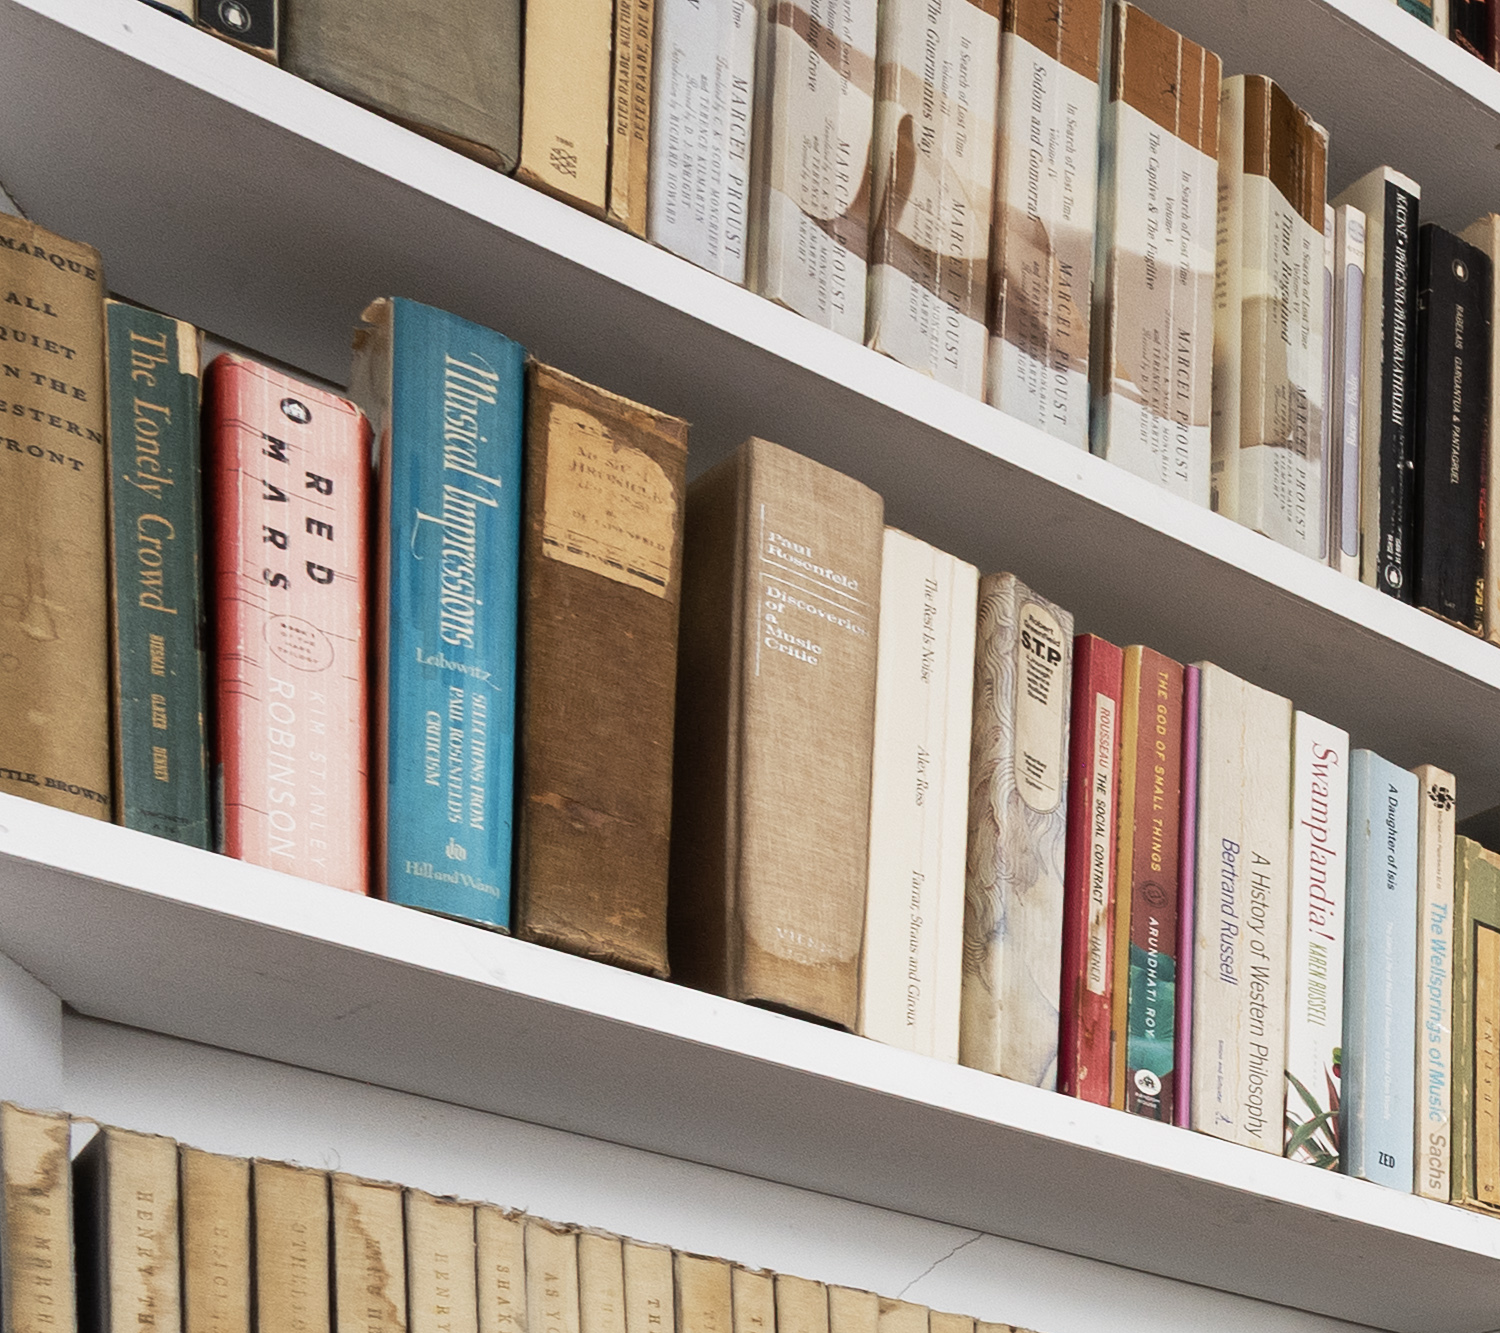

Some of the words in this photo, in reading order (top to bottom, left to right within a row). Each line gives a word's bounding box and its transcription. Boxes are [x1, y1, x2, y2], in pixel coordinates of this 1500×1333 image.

[130, 330, 167, 395] The
[131, 398, 172, 501] Lonely
[444, 353, 501, 492] Musical
[260, 435, 290, 591] MARS
[305, 473, 335, 586] RED
[132, 511, 174, 615] Crowd
[411, 489, 501, 647] Impressions
[1157, 671, 1168, 700] THE
[1154, 746, 1164, 764] OF
[1156, 707, 1166, 739] GOD
[269, 676, 298, 861] ROBINSON
[1153, 769, 1164, 816] SMALL
[1150, 822, 1163, 873] THINGS
[1220, 838, 1242, 915] Bertrand
[1252, 853, 1265, 866] A
[1308, 740, 1339, 942] Swamplandia!
[1250, 873, 1267, 930] History
[1146, 916, 1159, 1001] ARUNDHATI
[1219, 920, 1239, 987] Russell
[1249, 935, 1265, 954] of
[1143, 1008, 1156, 1040] ROY
[1247, 961, 1268, 1034] Western
[1244, 1040, 1267, 1138] Philosophy
